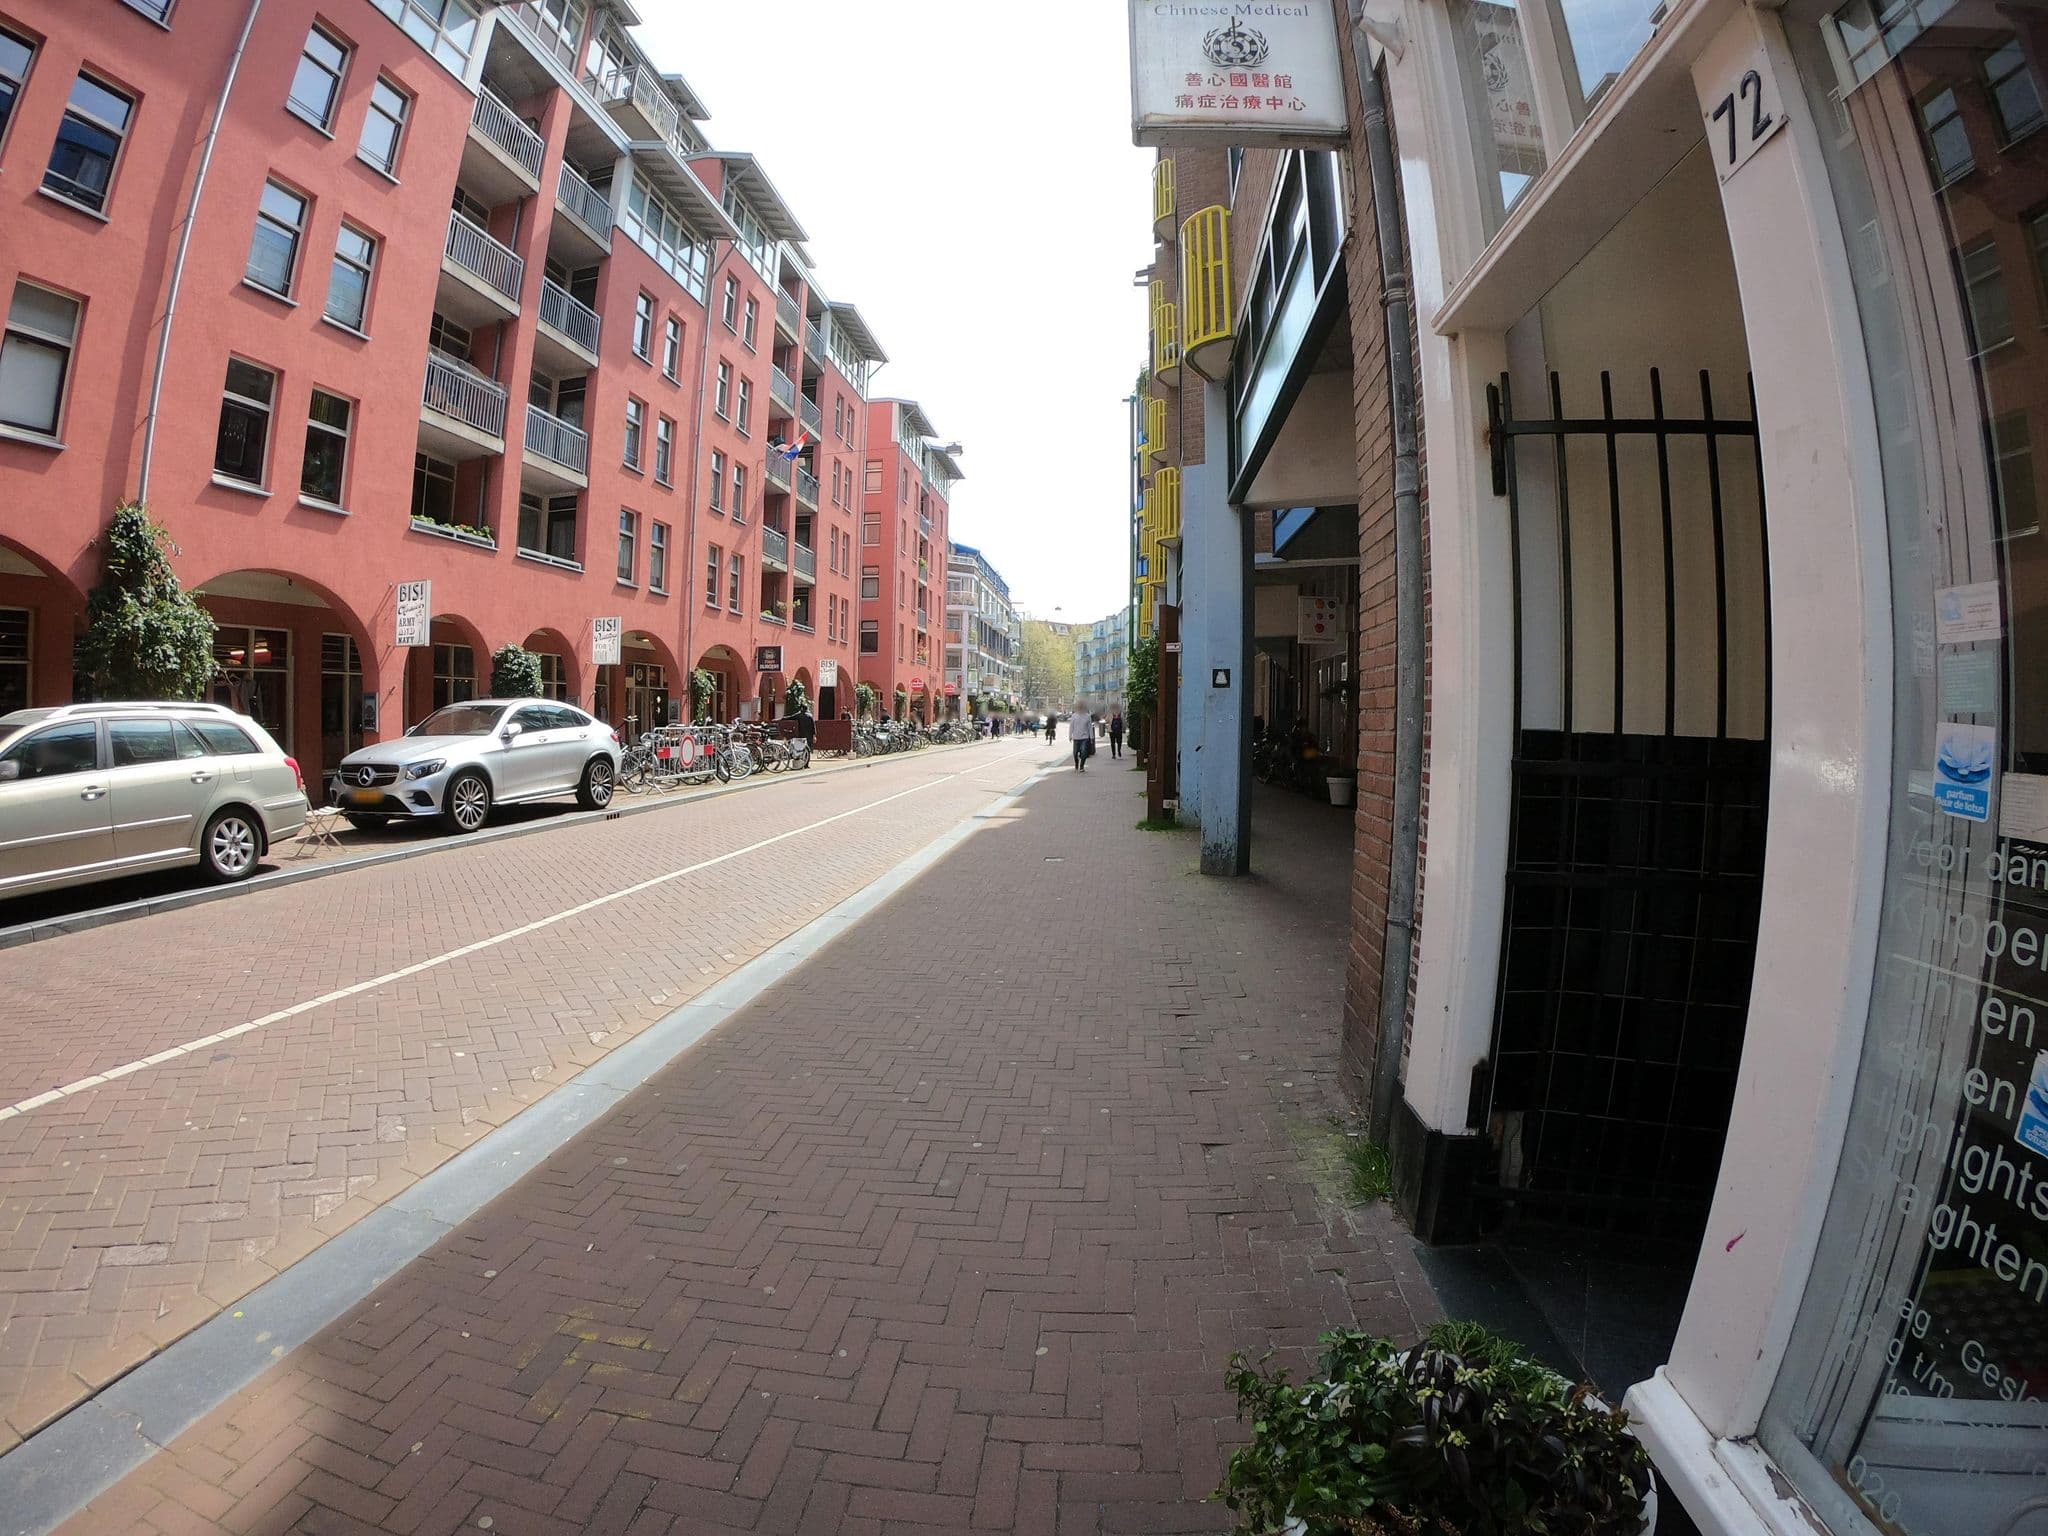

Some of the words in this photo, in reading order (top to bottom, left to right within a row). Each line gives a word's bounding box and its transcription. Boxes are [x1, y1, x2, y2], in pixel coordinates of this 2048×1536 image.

[1154, 3, 1230, 16] Chinese
[1235, 3, 1310, 17] Medical
[1184, 72, 1293, 89] 善心國醫館
[1174, 94, 1306, 112] 痛症治療中心
[1712, 69, 1773, 165] 72
[399, 583, 424, 602] BIS!
[595, 619, 616, 632] BIS!
[1946, 790, 1974, 801] parfum
[1965, 802, 1985, 814] lotus
